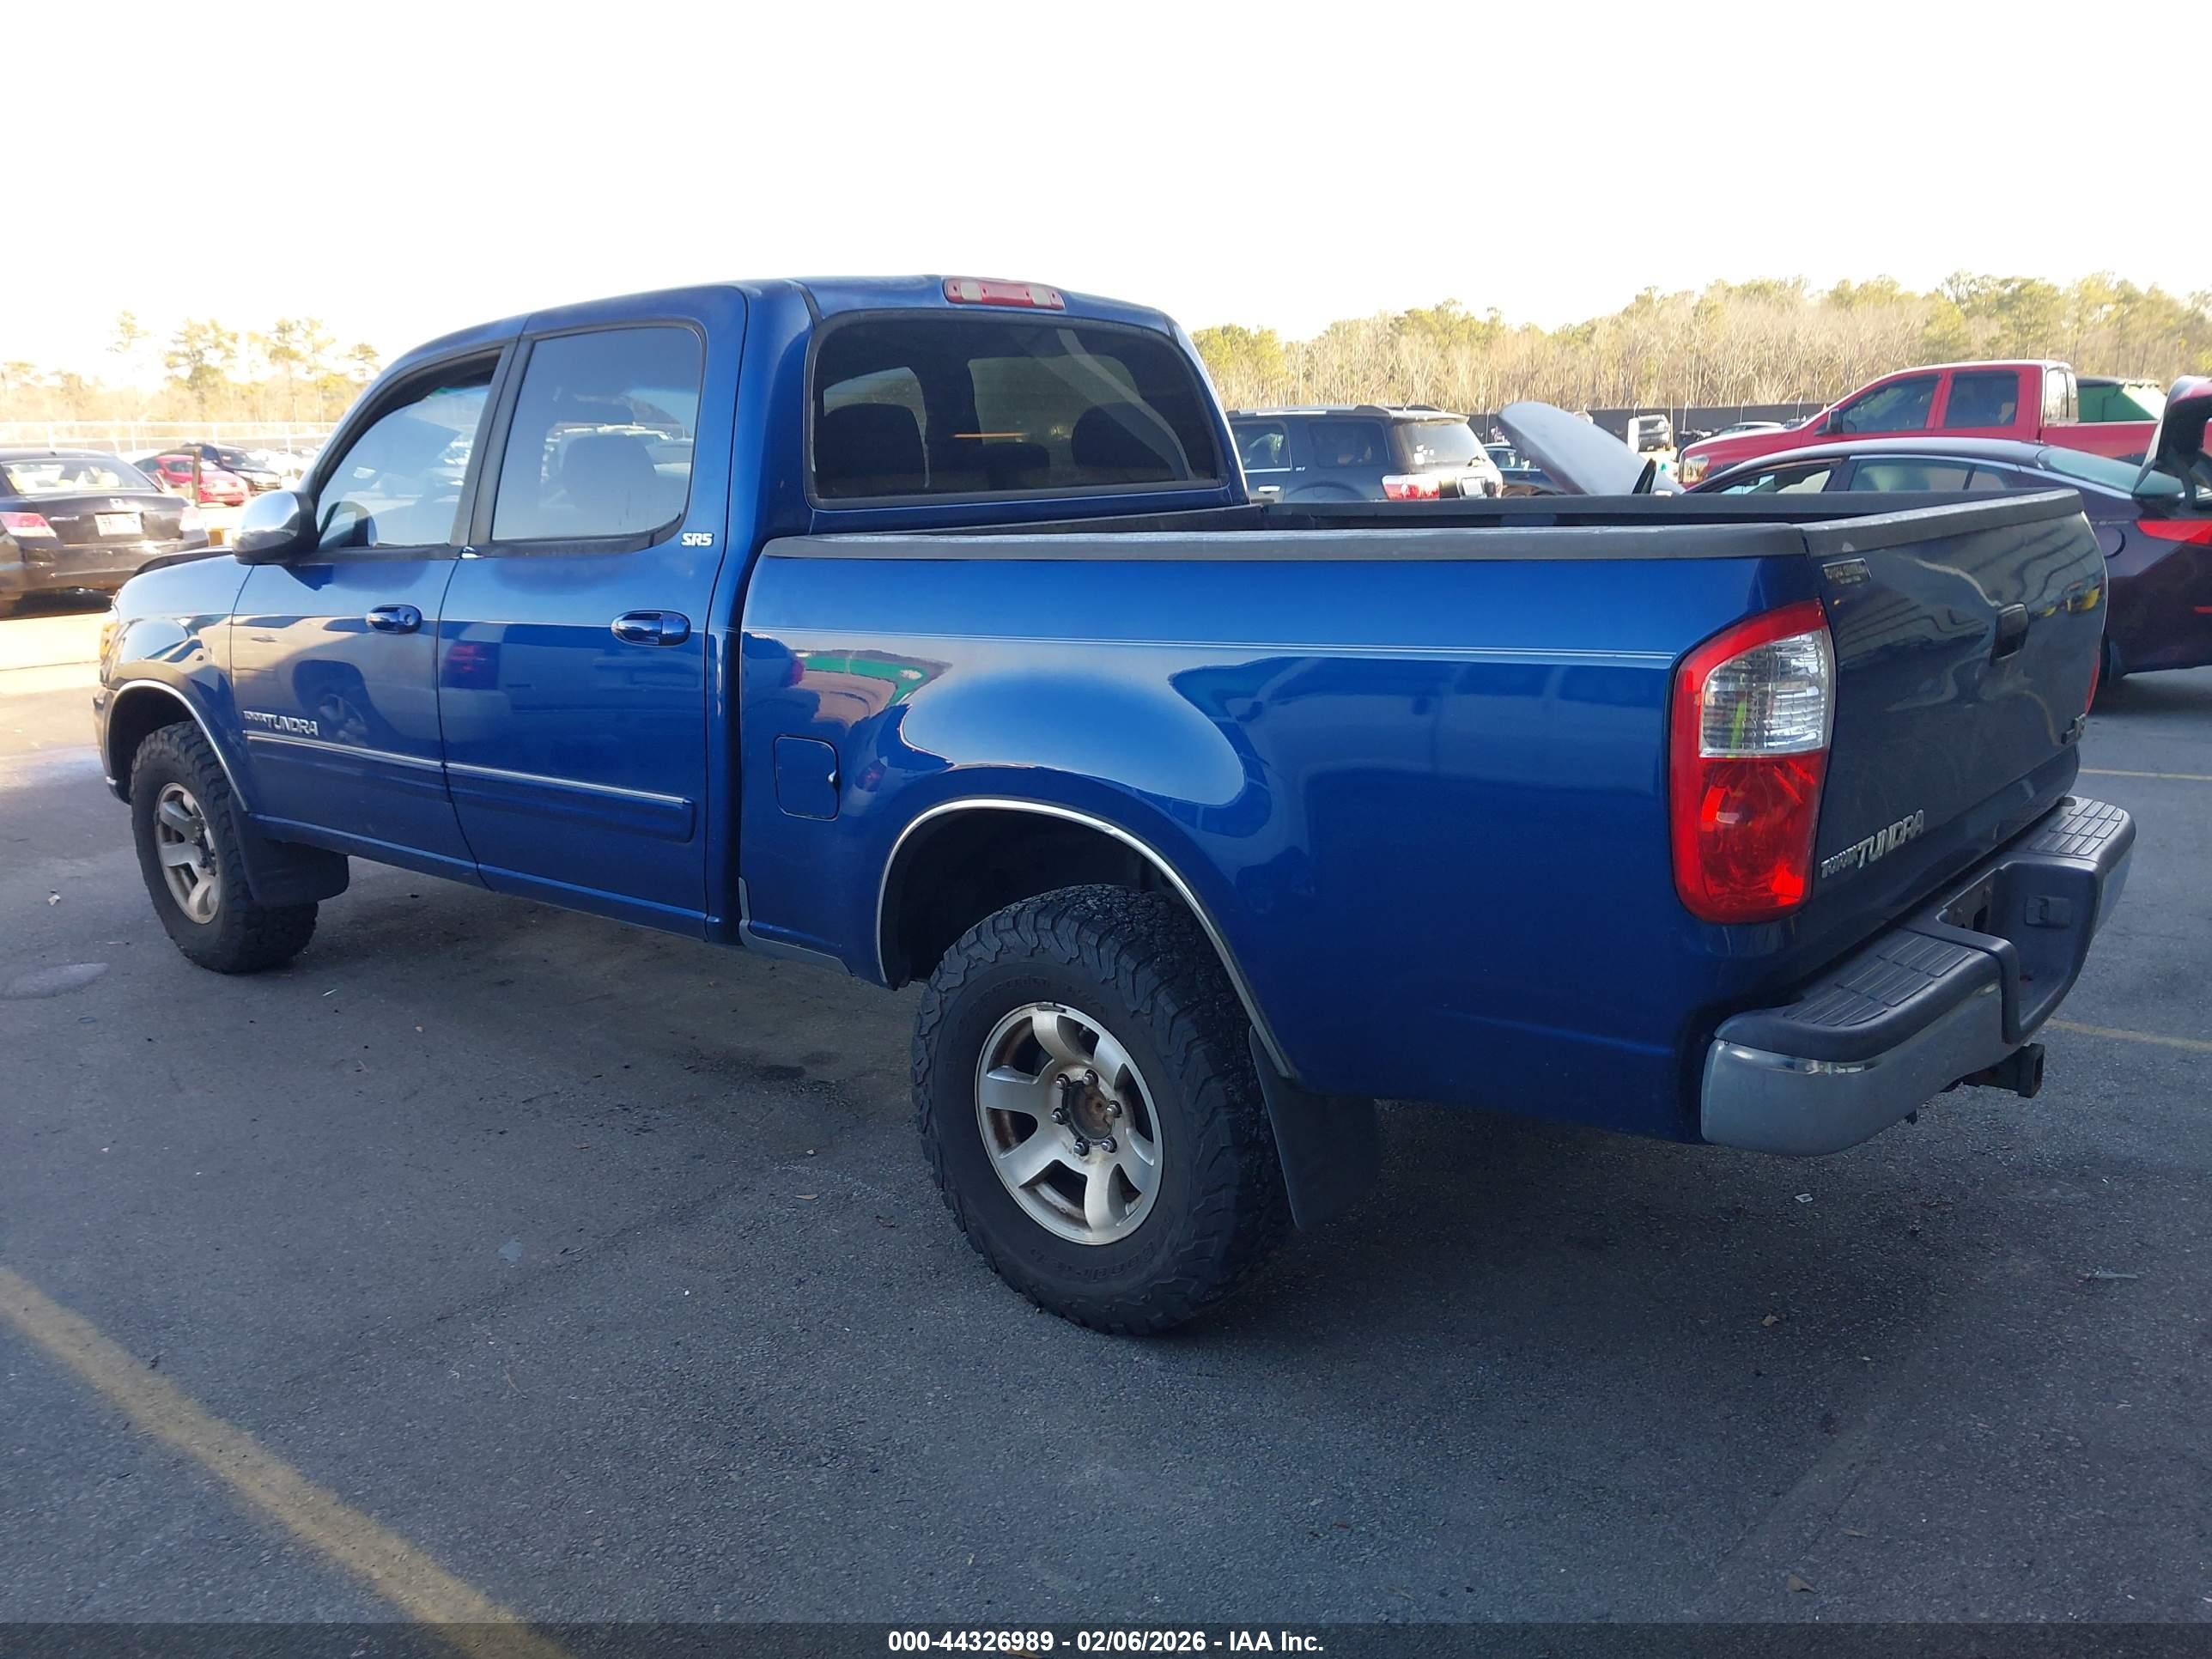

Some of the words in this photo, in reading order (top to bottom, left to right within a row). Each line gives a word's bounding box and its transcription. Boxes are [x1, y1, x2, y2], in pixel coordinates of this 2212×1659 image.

[681, 532, 713, 546] SR5
[266, 714, 319, 736] TUNDRA
[1856, 809, 1923, 869] TUNDRA
